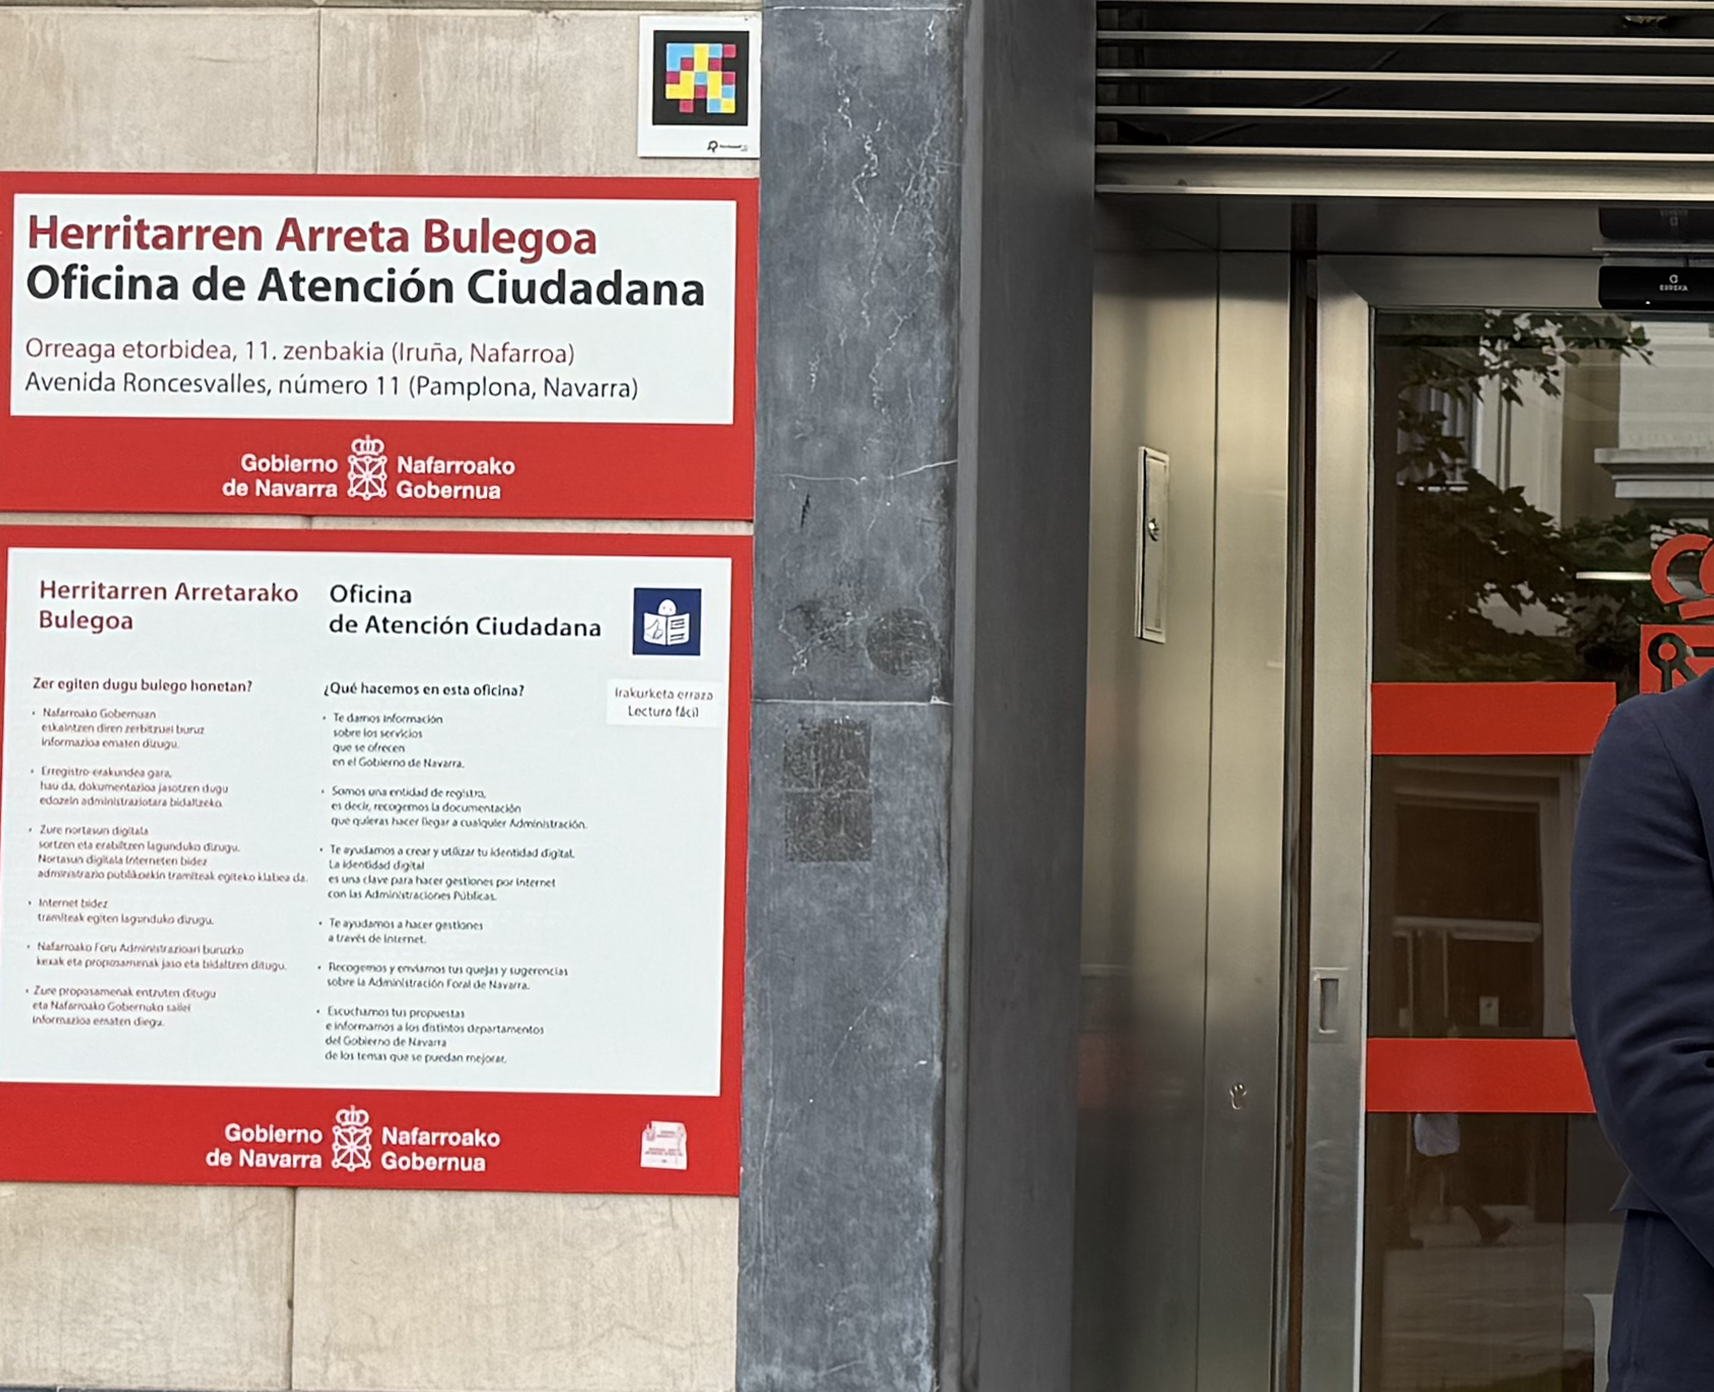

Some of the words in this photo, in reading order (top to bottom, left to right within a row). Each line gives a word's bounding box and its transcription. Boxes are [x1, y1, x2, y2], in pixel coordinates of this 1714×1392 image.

[29, 214, 262, 251] Herritarren
[276, 217, 408, 252] Arreta
[425, 217, 596, 264] Bulegoa
[27, 263, 178, 300] Oficina
[193, 265, 245, 301] de
[258, 267, 453, 303] Atención
[468, 269, 704, 306] Ciudadana
[26, 338, 115, 363] Orreaga
[123, 339, 236, 362] etorbidea,
[247, 341, 276, 360] 11.
[284, 340, 383, 361] zenbakia
[392, 342, 462, 365] (Iruña,
[471, 342, 574, 366] Nafarroa)
[26, 371, 115, 391] Avenida
[124, 372, 271, 396] Roncesvalles,
[279, 374, 367, 395] número
[379, 376, 397, 395] 11
[410, 376, 535, 401] (Pamplona,
[544, 377, 637, 400] Navarra)
[241, 454, 338, 473] Gobierno
[398, 456, 515, 474] Nafarroako
[222, 478, 248, 496] de
[256, 479, 337, 497] Navarra
[397, 480, 500, 499] Gobernua
[41, 580, 166, 600] Herritarren
[175, 582, 298, 602] Arretarako
[330, 584, 411, 603] Oficina
[40, 610, 132, 634] Bulegoa
[330, 614, 357, 633] de
[365, 615, 468, 635] Atención
[476, 617, 600, 636] Ciudadana
[33, 677, 53, 689] Zer
[58, 678, 99, 692] egiten
[103, 678, 137, 693] dugu
[141, 679, 187, 694] bulego
[191, 680, 252, 692] honetan?
[324, 682, 357, 696] ¿Qué
[361, 682, 419, 695] hacemos
[423, 686, 439, 695] en
[443, 685, 469, 695] esta
[474, 684, 524, 696] oficina?
[334, 728, 361, 737] sobre
[333, 744, 352, 753] que
[359, 757, 405, 767] Gobierno
[391, 877, 413, 886] para
[416, 876, 442, 885] hacer
[405, 920, 432, 929] hacer
[225, 1123, 322, 1143] Gobierno
[382, 1127, 500, 1147] Nafarroako
[206, 1148, 232, 1166] de
[240, 1149, 321, 1168] Navarra
[381, 1151, 485, 1171] Gobernua
